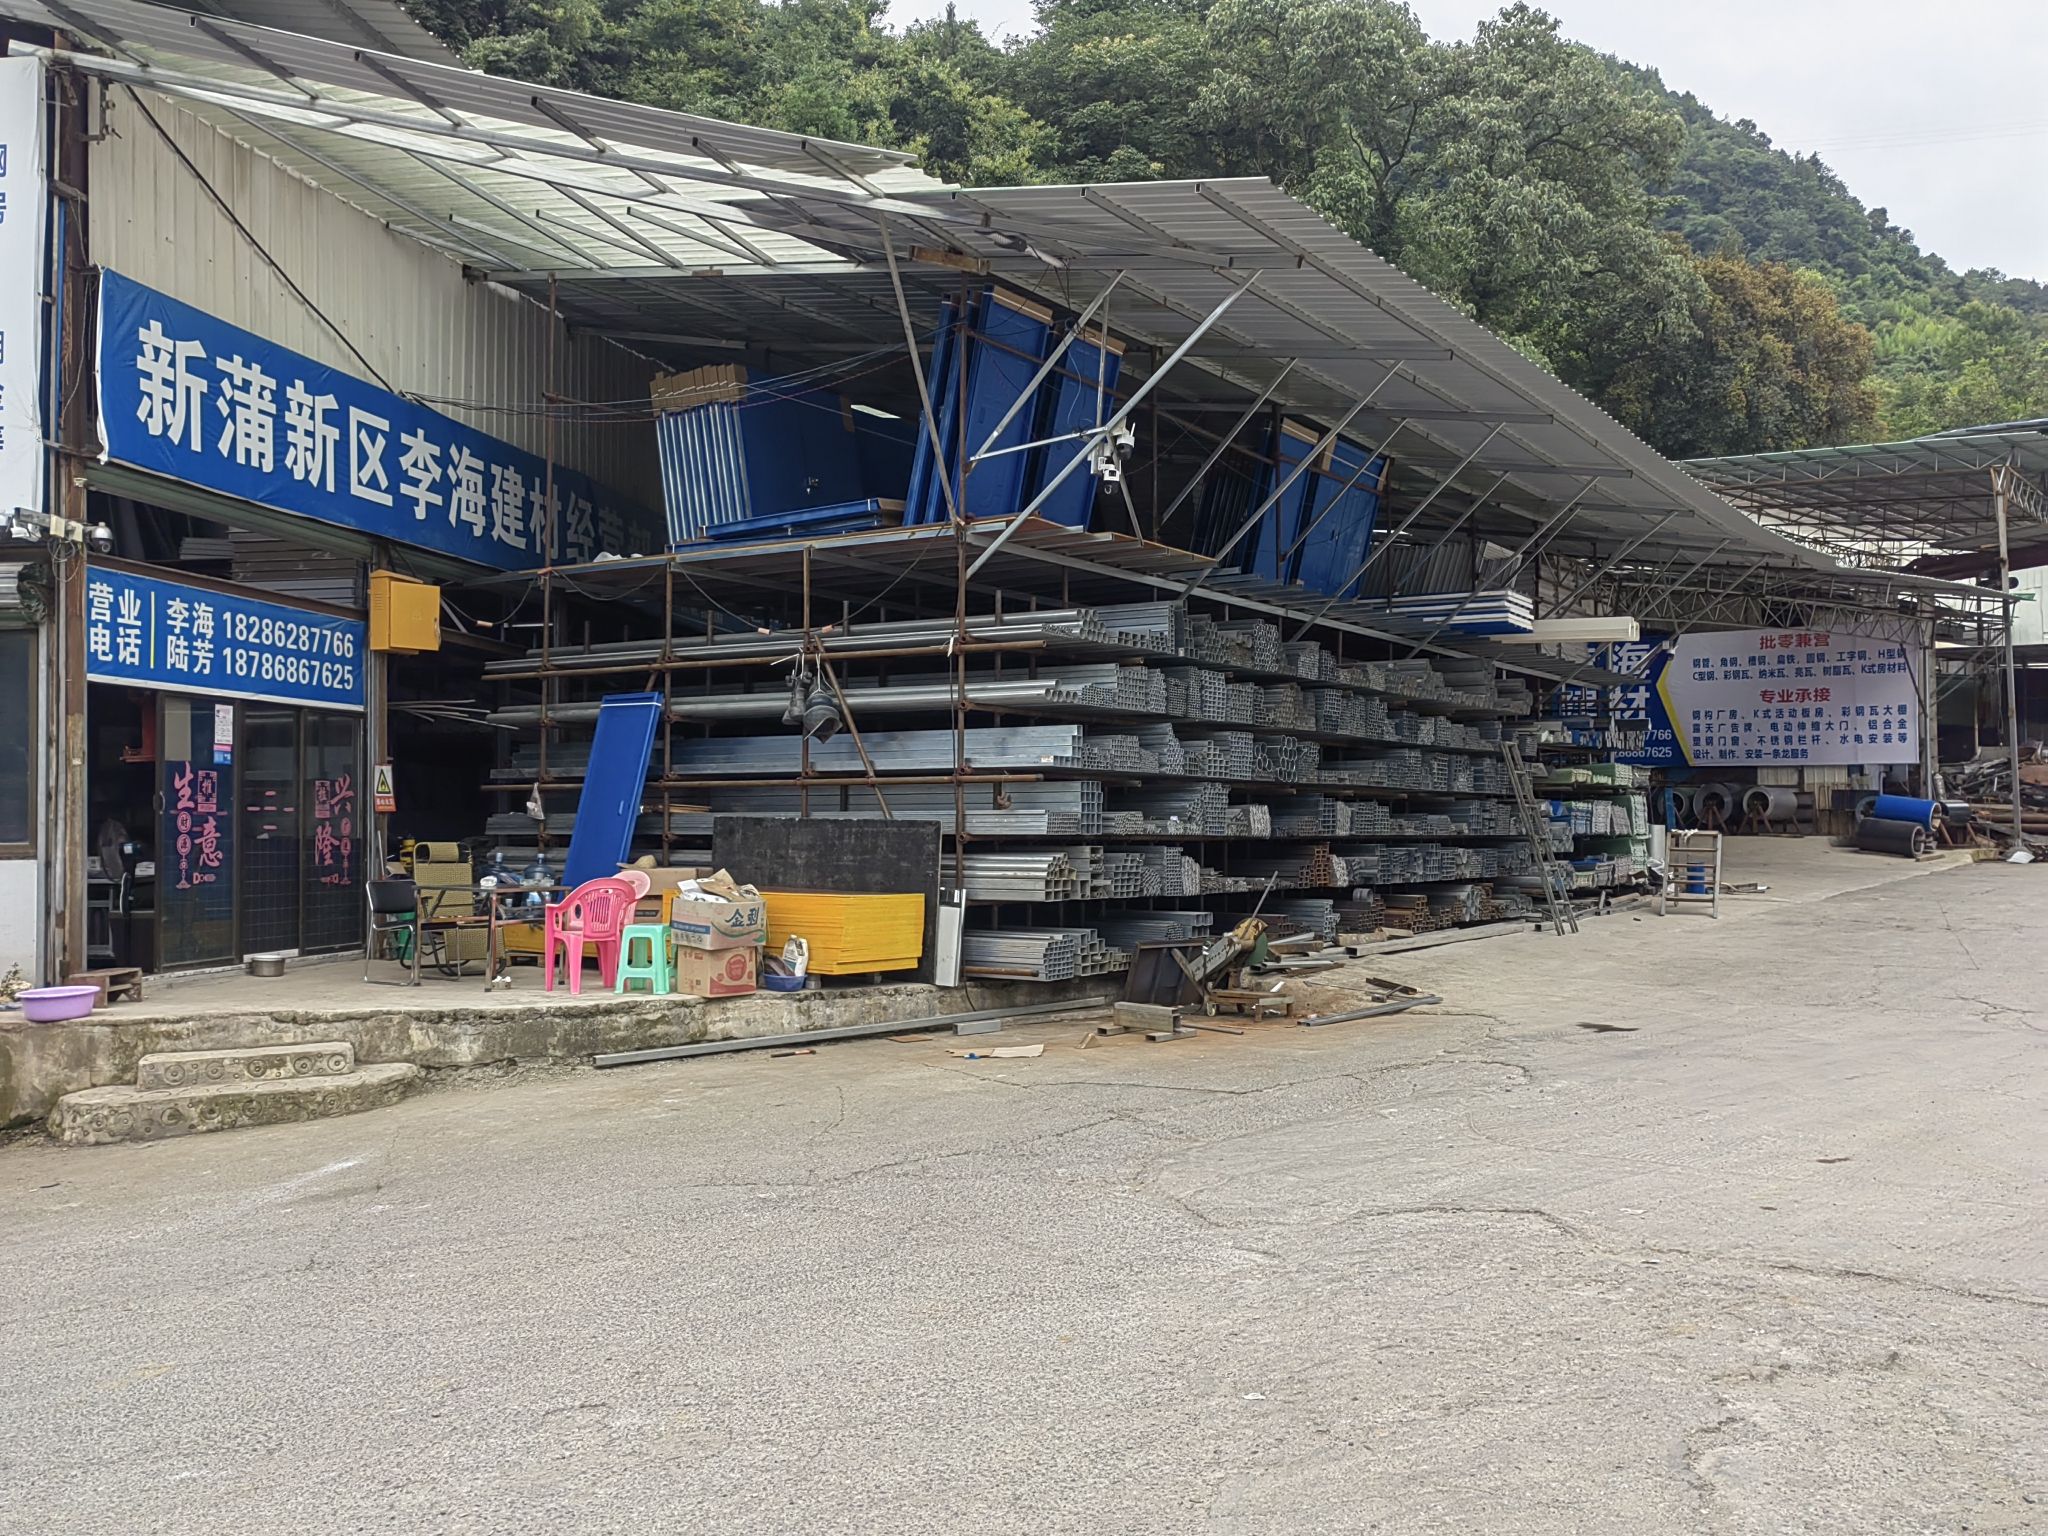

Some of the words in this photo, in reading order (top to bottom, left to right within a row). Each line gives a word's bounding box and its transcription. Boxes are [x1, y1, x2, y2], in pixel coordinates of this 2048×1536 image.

[89, 581, 142, 626] 营业
[89, 622, 142, 666] 电话
[166, 598, 214, 639] 李海
[223, 612, 354, 658] 18286287766
[1759, 633, 1831, 650] 批零兼营
[167, 635, 214, 675] 陆芳
[223, 648, 353, 690] 18786867625
[1760, 687, 1831, 704] 专业承接
